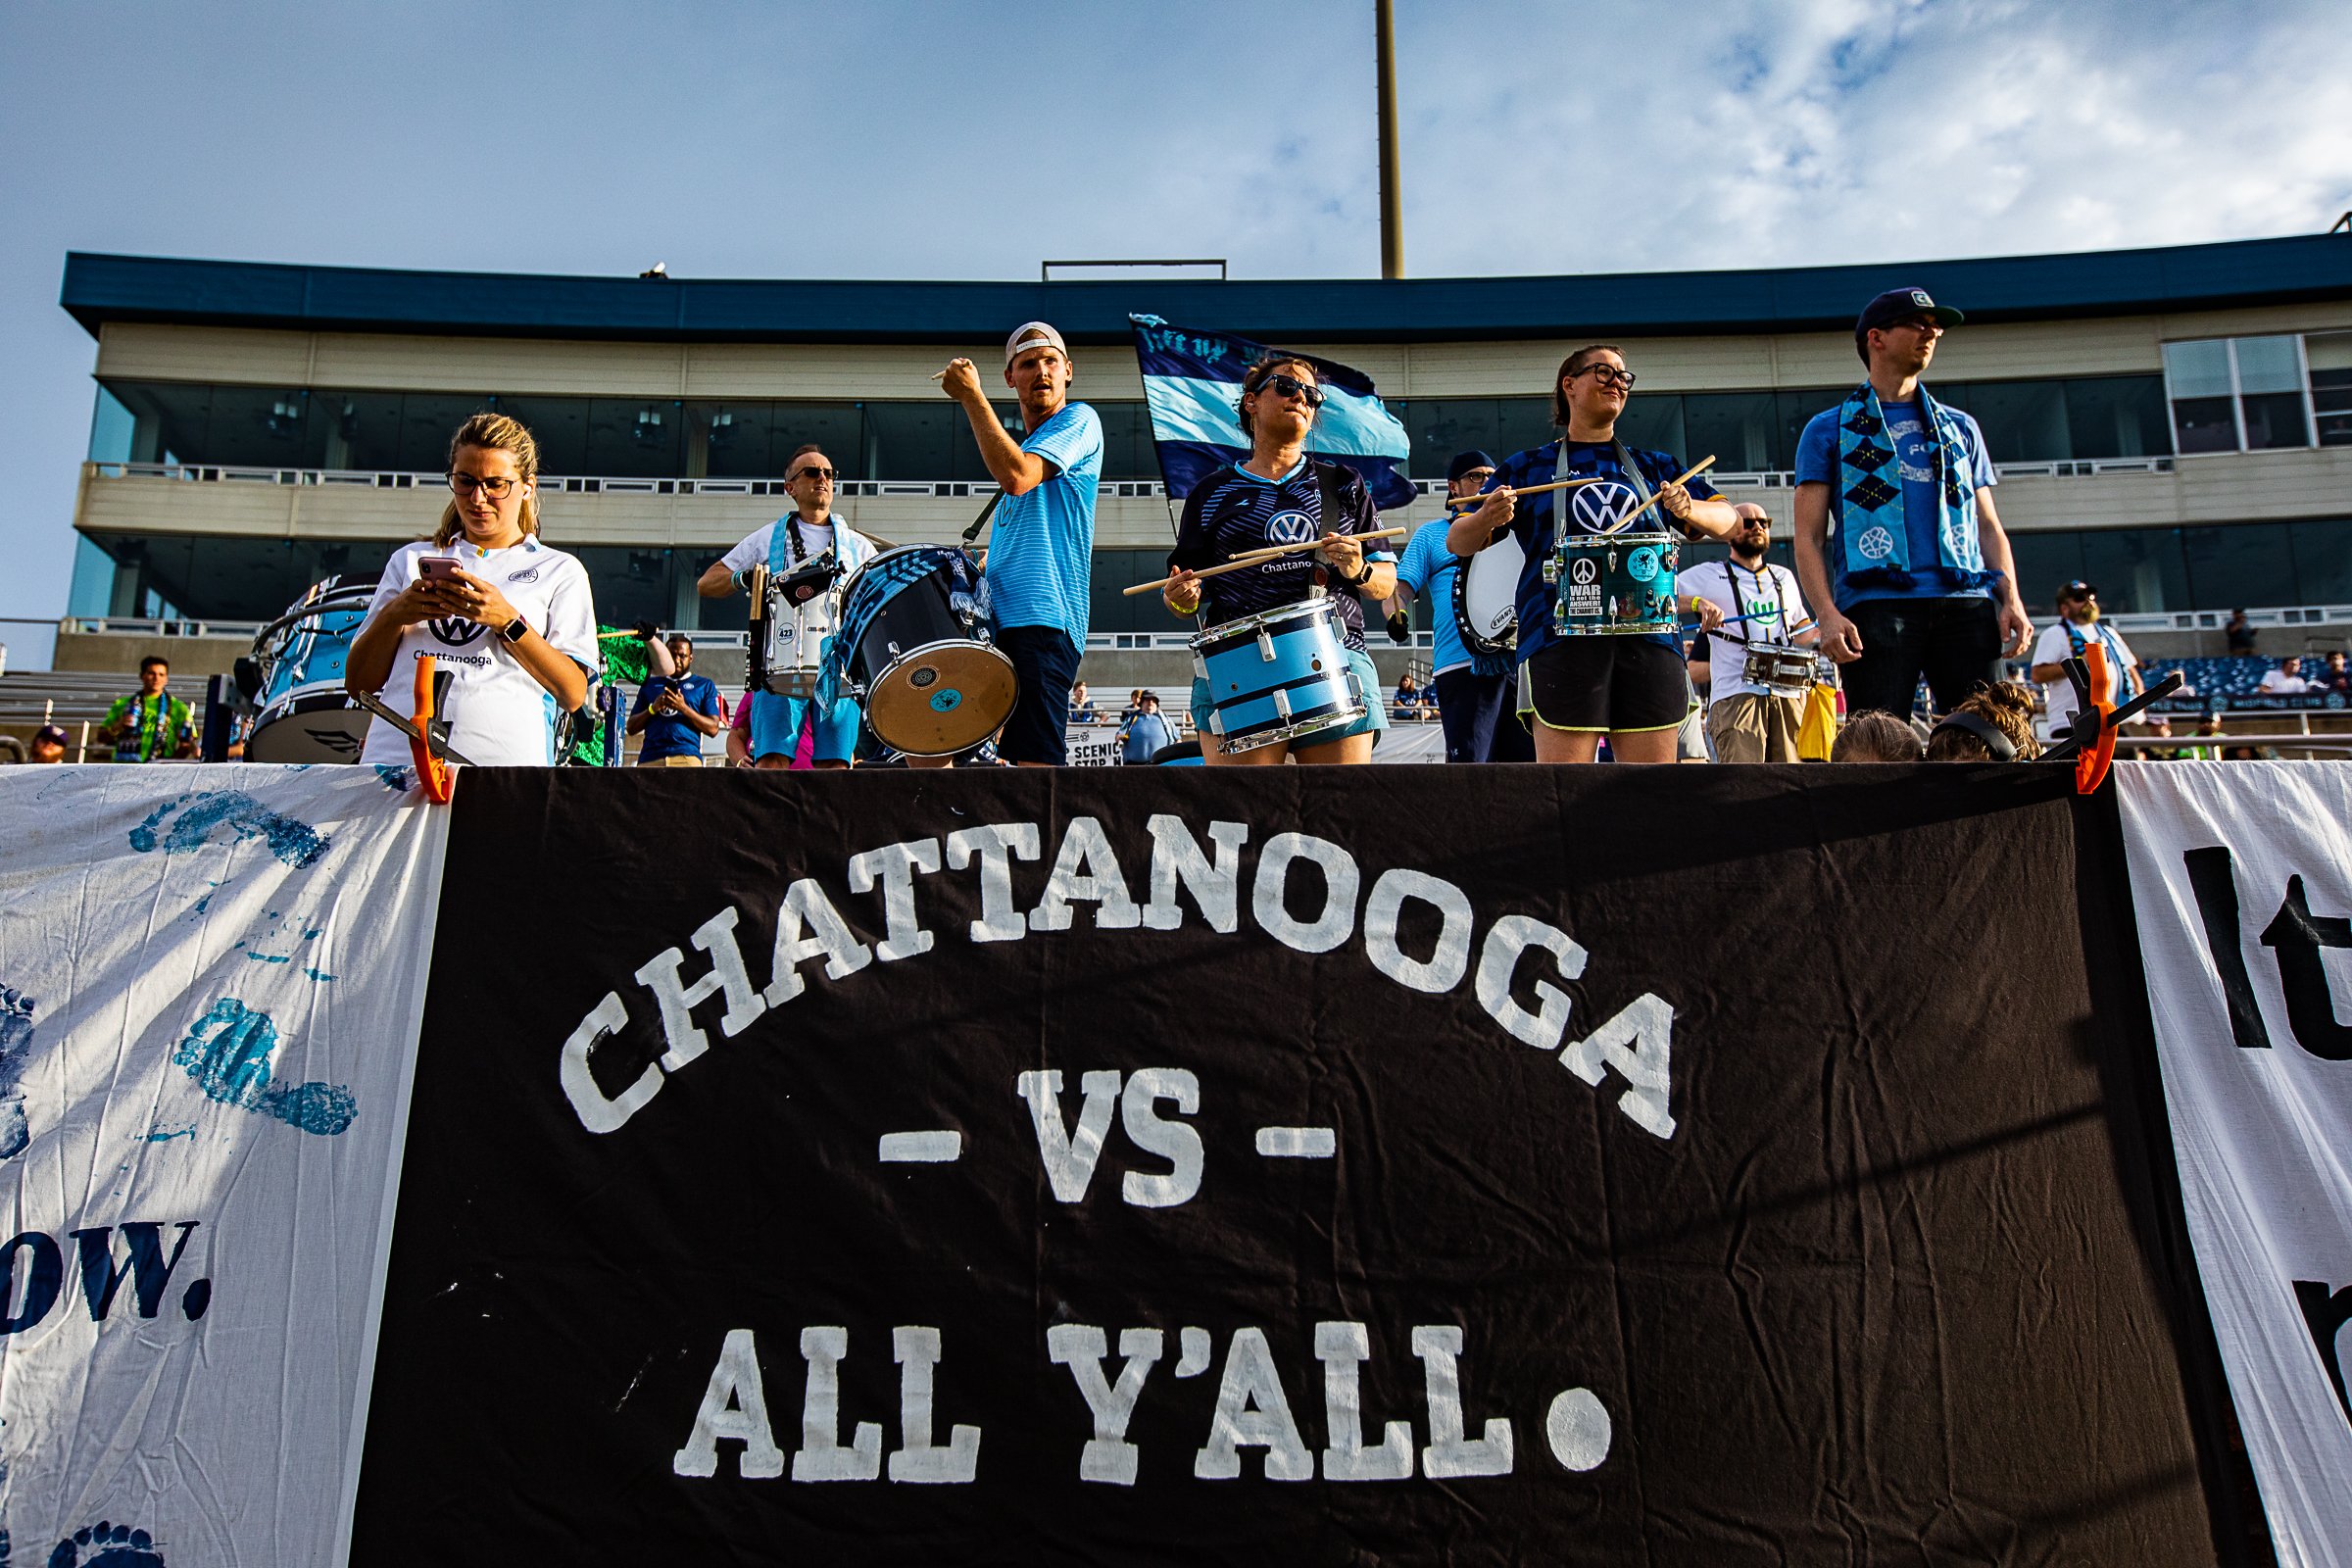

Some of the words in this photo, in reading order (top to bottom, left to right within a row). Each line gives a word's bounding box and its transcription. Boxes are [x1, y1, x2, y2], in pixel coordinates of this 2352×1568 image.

[1261, 561, 1313, 574] Chattano
[1570, 584, 1601, 596] WAR
[1493, 607, 1513, 627] EVANS
[779, 629, 793, 638] 423
[1074, 743, 1120, 759] SCENIC
[560, 813, 1677, 1140] CHATTANOOGA
[1016, 1067, 1205, 1208] VS
[673, 1325, 982, 1484] ALL
